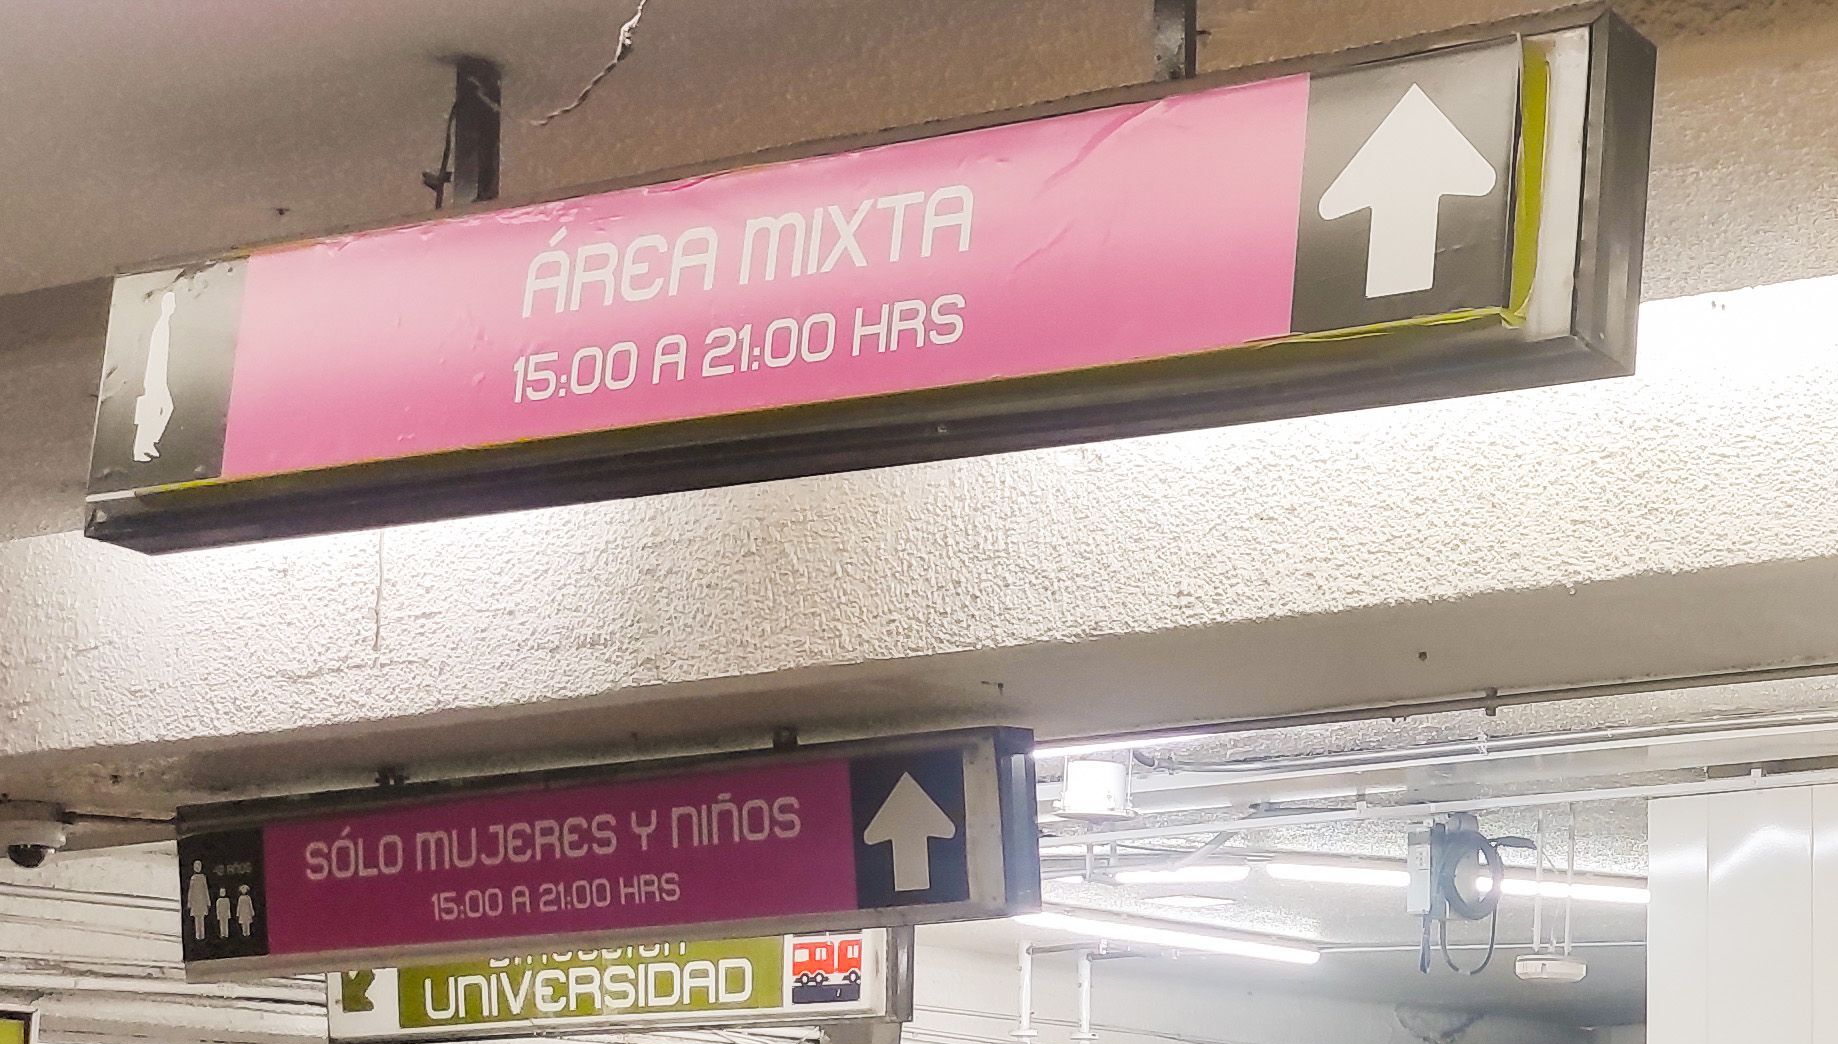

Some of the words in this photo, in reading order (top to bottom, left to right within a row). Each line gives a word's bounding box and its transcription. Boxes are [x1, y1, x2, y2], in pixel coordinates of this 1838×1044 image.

[522, 226, 718, 319] ÁREA
[739, 184, 974, 286] MIXTA
[512, 341, 638, 403] 15:00
[652, 333, 687, 385] A
[702, 312, 836, 378] 21:00
[852, 294, 966, 357] HRS
[305, 826, 403, 881] SÓLO
[416, 813, 617, 872] MUJERES
[631, 809, 657, 851] Y
[671, 793, 801, 849] NIÑOS
[431, 887, 503, 921] 15:00
[512, 885, 531, 914] A
[539, 878, 611, 912] 21:00
[620, 872, 681, 905] HRS
[424, 958, 753, 1020] UNIVERSIDAD
